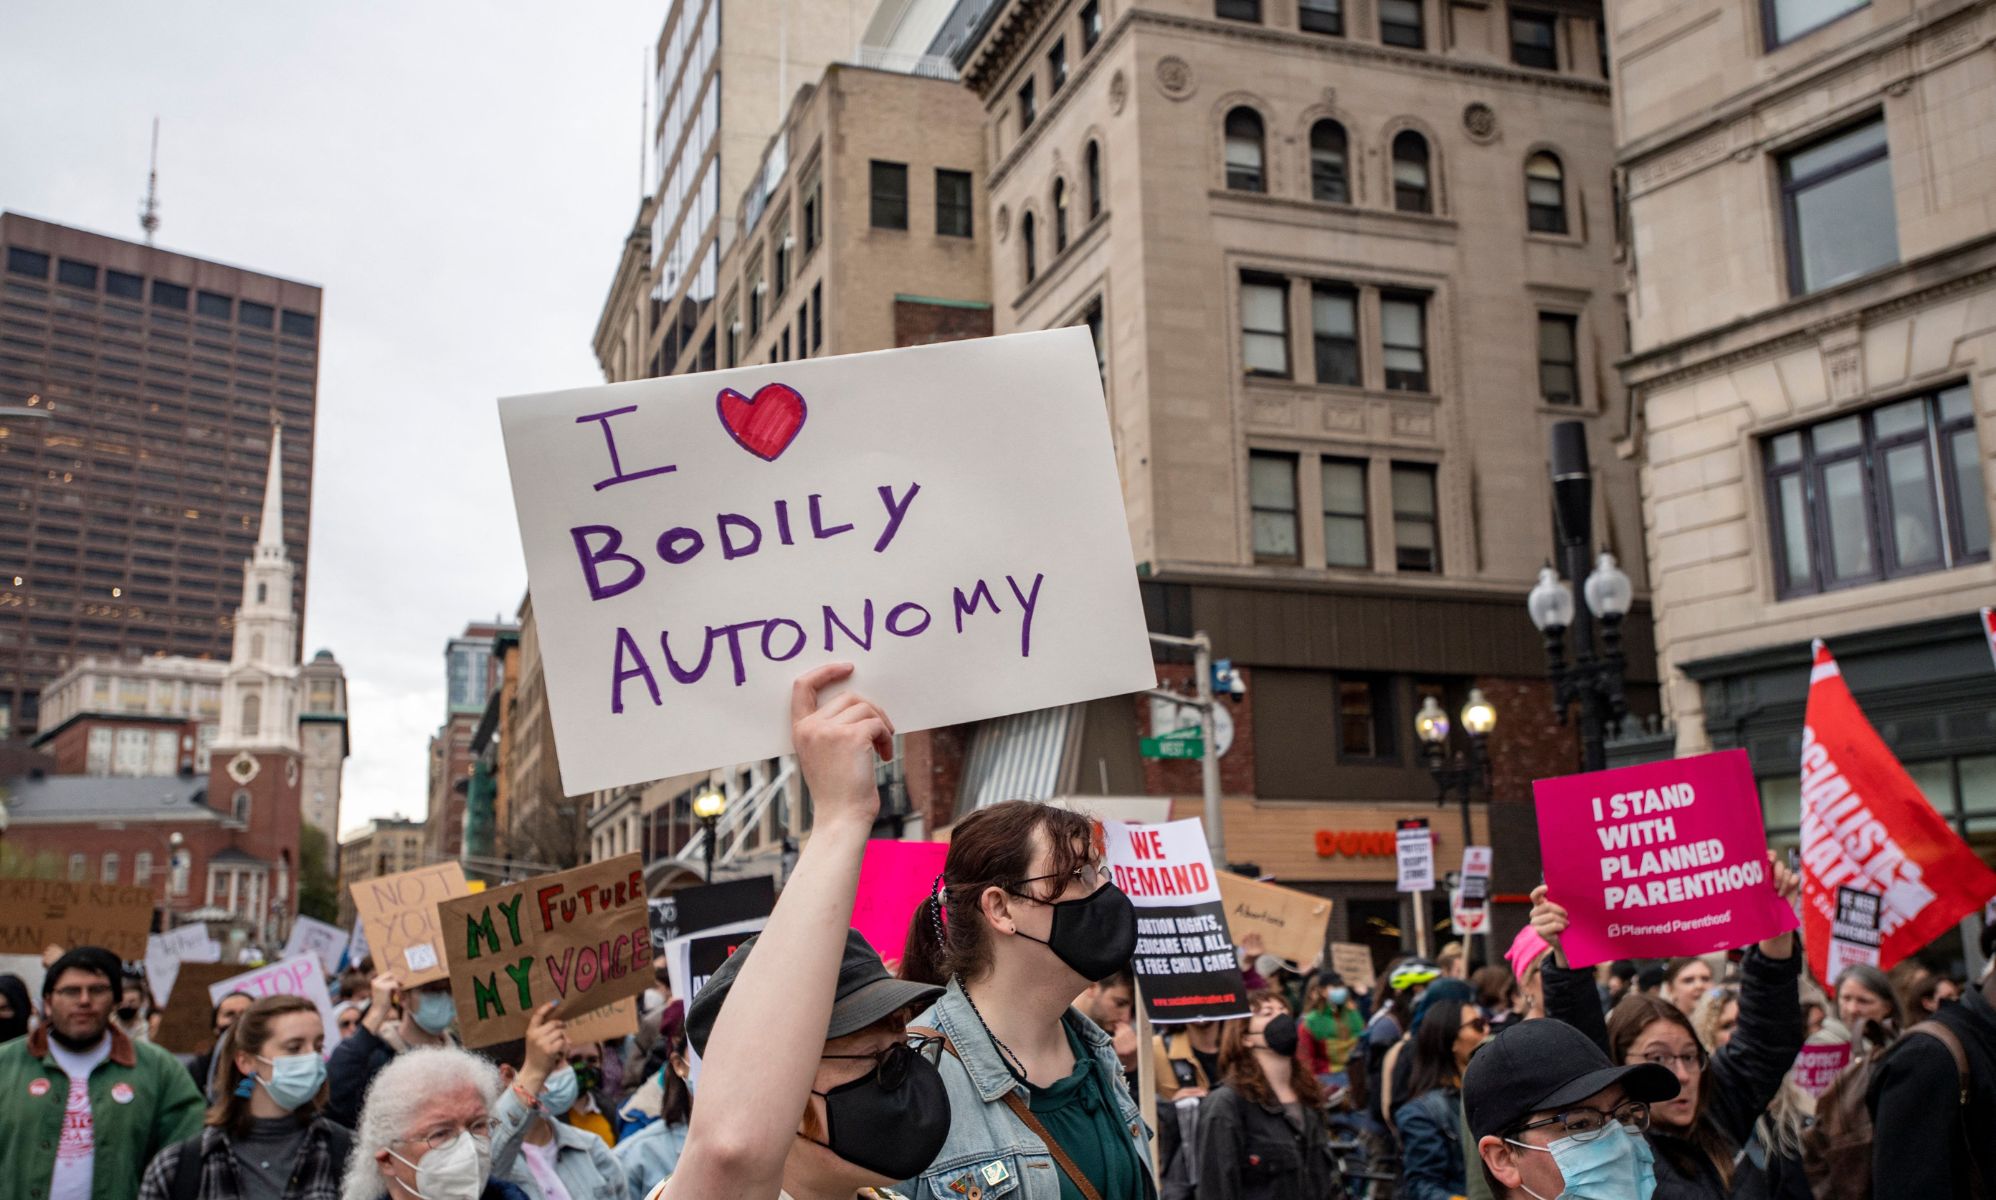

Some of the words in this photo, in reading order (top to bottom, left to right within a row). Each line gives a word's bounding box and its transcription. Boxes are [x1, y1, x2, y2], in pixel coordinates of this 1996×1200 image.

[576, 405, 677, 491] I
[570, 482, 921, 601] BODILY
[610, 572, 1044, 714] AUTONOMY
[1592, 797, 1603, 822] I
[1609, 782, 1696, 819] STAND
[1129, 831, 1166, 860] WE
[1597, 816, 1677, 851] WITH
[1114, 863, 1210, 896] DEMAND
[1600, 838, 1724, 881] PLANNED
[371, 870, 454, 912] NOT
[1603, 860, 1763, 911] PARENTHOOD
[467, 893, 522, 959] MY
[537, 870, 643, 932] FUTURE
[1175, 914, 1222, 933] RIGHTS,
[1622, 921, 1672, 936] Planned
[1672, 910, 1732, 932] Parenthood
[1135, 960, 1145, 974] &
[1144, 958, 1171, 974] FREE
[1169, 957, 1203, 974] CHILD
[1202, 952, 1236, 972] CARE
[1180, 937, 1203, 953] FOR
[1203, 933, 1232, 951] ALL,
[472, 956, 533, 1020] MY
[546, 926, 650, 999] VOICE
